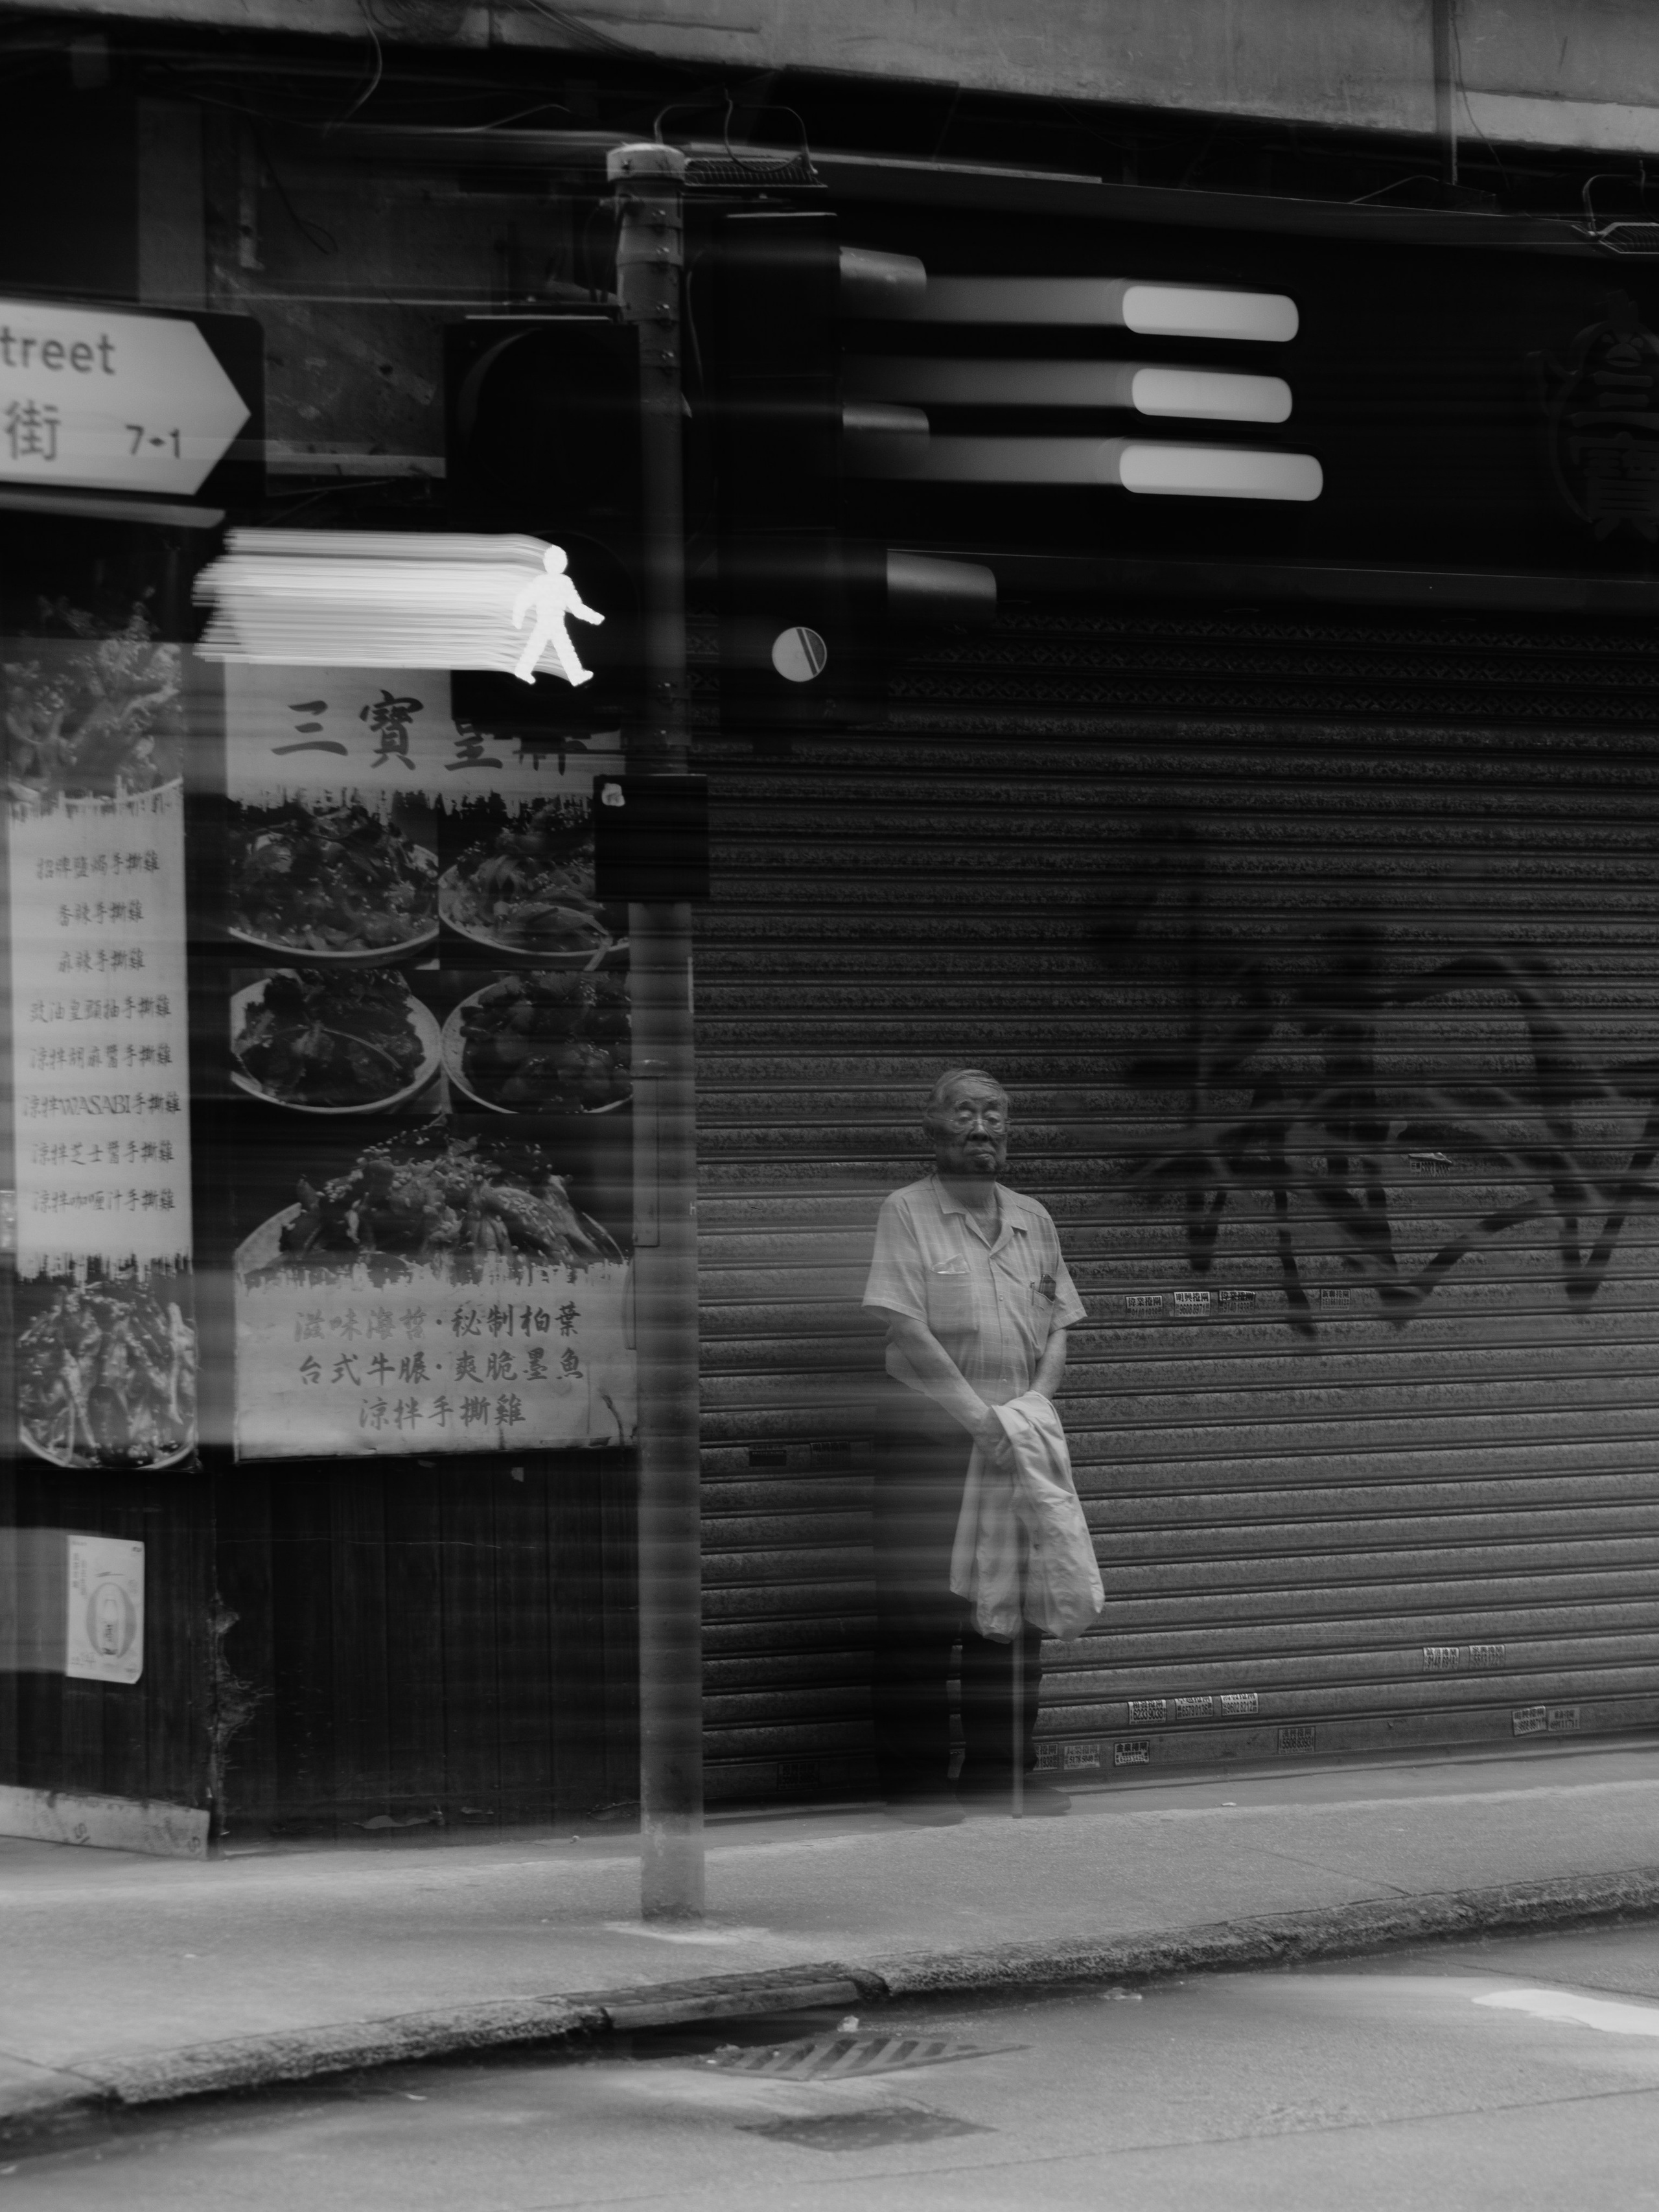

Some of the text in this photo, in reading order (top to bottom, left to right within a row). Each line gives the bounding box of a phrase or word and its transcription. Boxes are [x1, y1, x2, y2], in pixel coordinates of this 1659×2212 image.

[3, 399, 62, 461] 街
[270, 688, 588, 776] 三寶皇
[358, 1391, 527, 1432] 涼拌手撕雞
